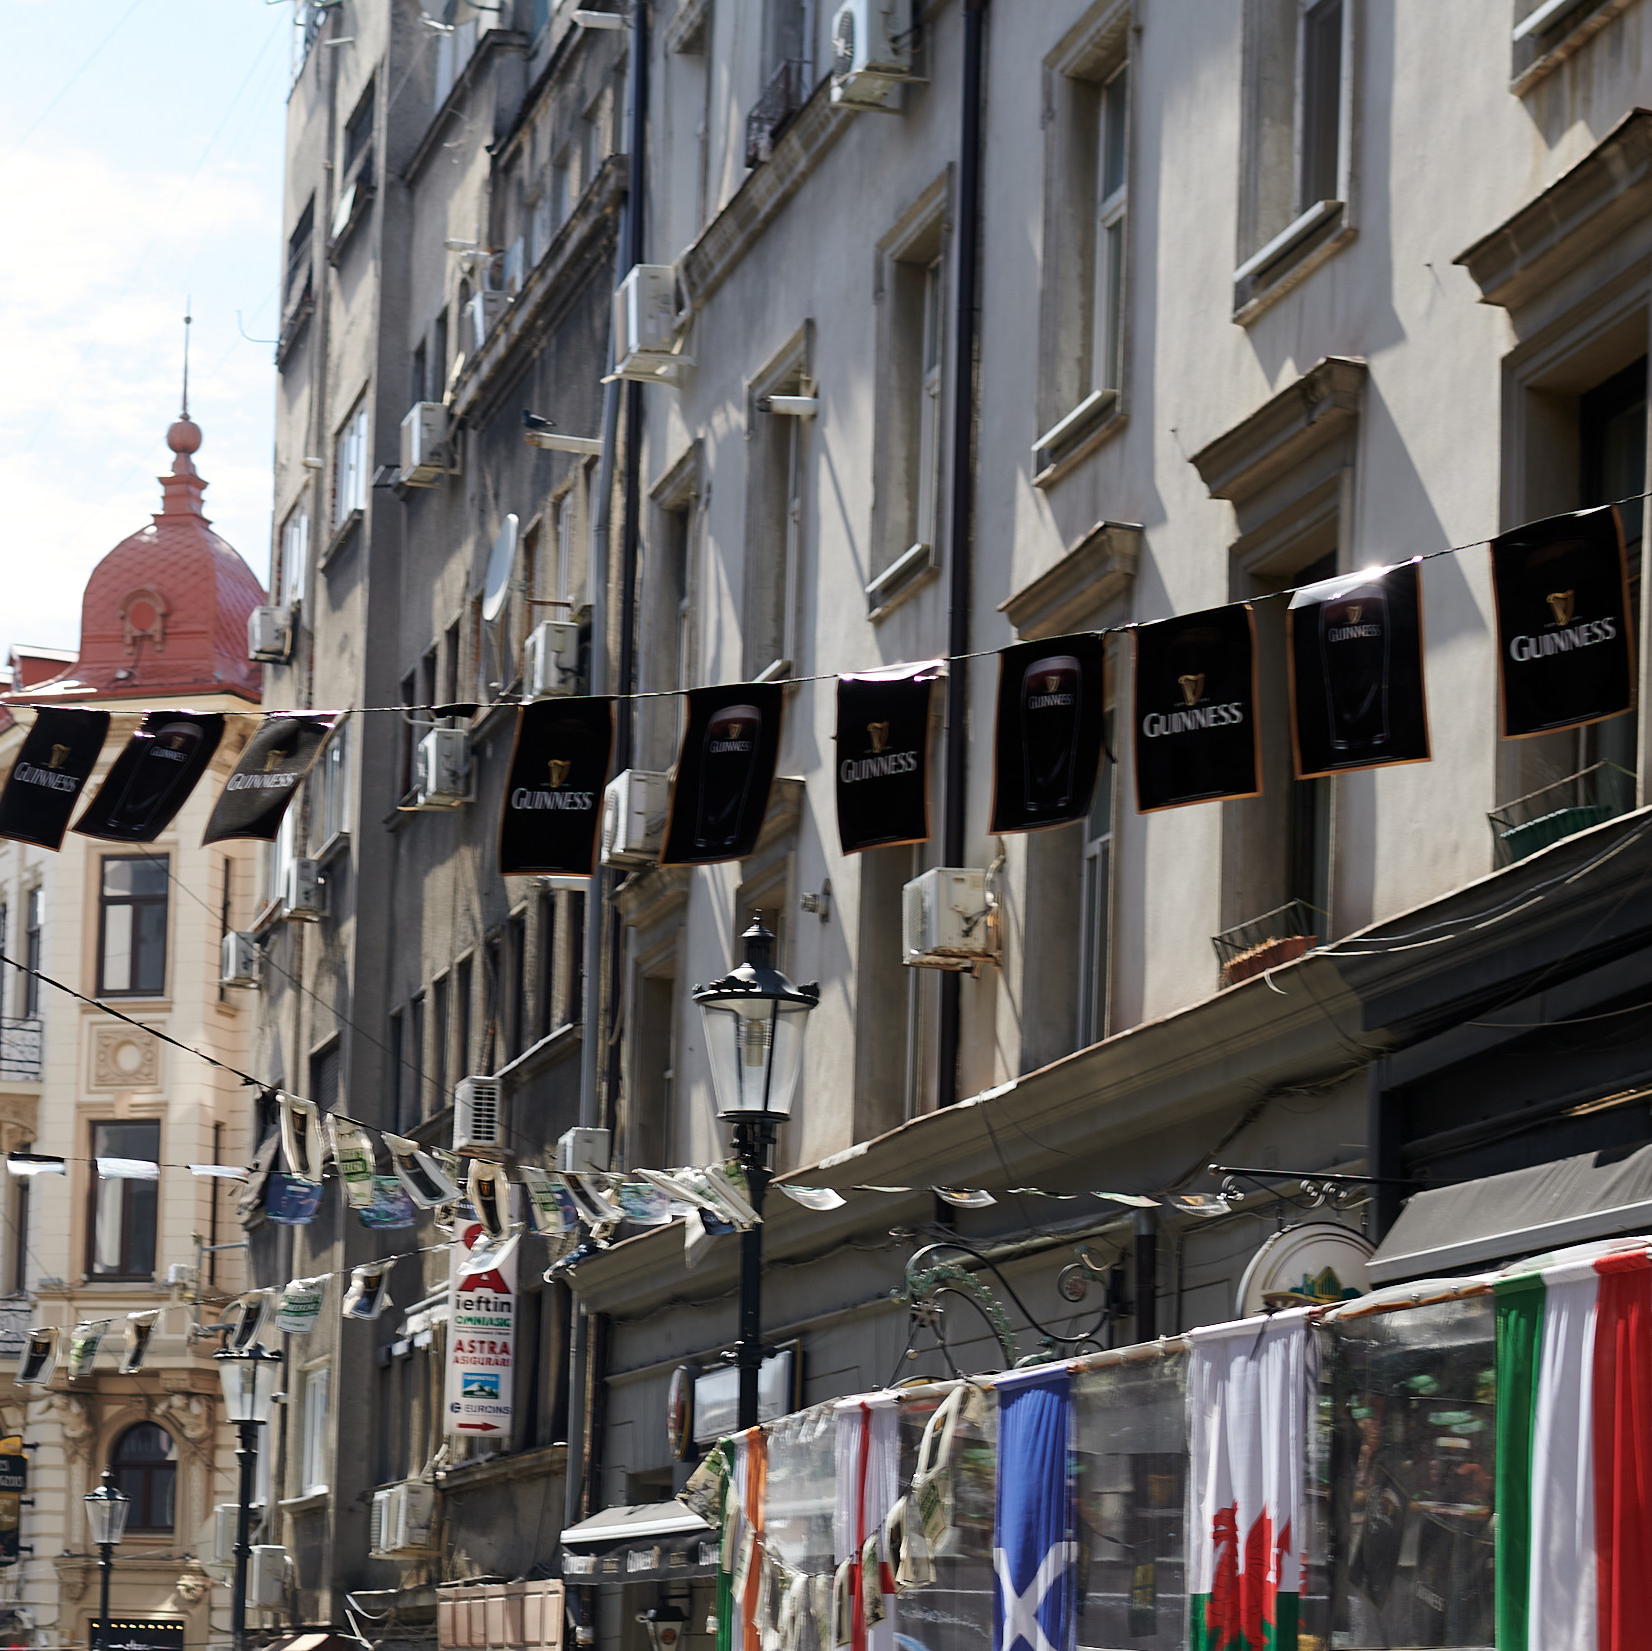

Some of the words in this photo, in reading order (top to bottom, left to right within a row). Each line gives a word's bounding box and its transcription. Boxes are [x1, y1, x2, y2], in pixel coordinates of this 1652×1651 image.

[1327, 624, 1381, 643] GUINNESS
[1509, 616, 1617, 663] GUINNESS
[1027, 692, 1075, 710] GUINNESS
[1142, 701, 1244, 738] GUINNESS
[14, 761, 82, 793] GUINNESS
[840, 750, 918, 783] GUINNESS
[227, 771, 299, 792] GUINNESS
[511, 788, 594, 812] GUINNESS
[455, 1294, 512, 1313] ieftin
[453, 1339, 512, 1356] ASTRA
[464, 1403, 513, 1415] EUROINS
